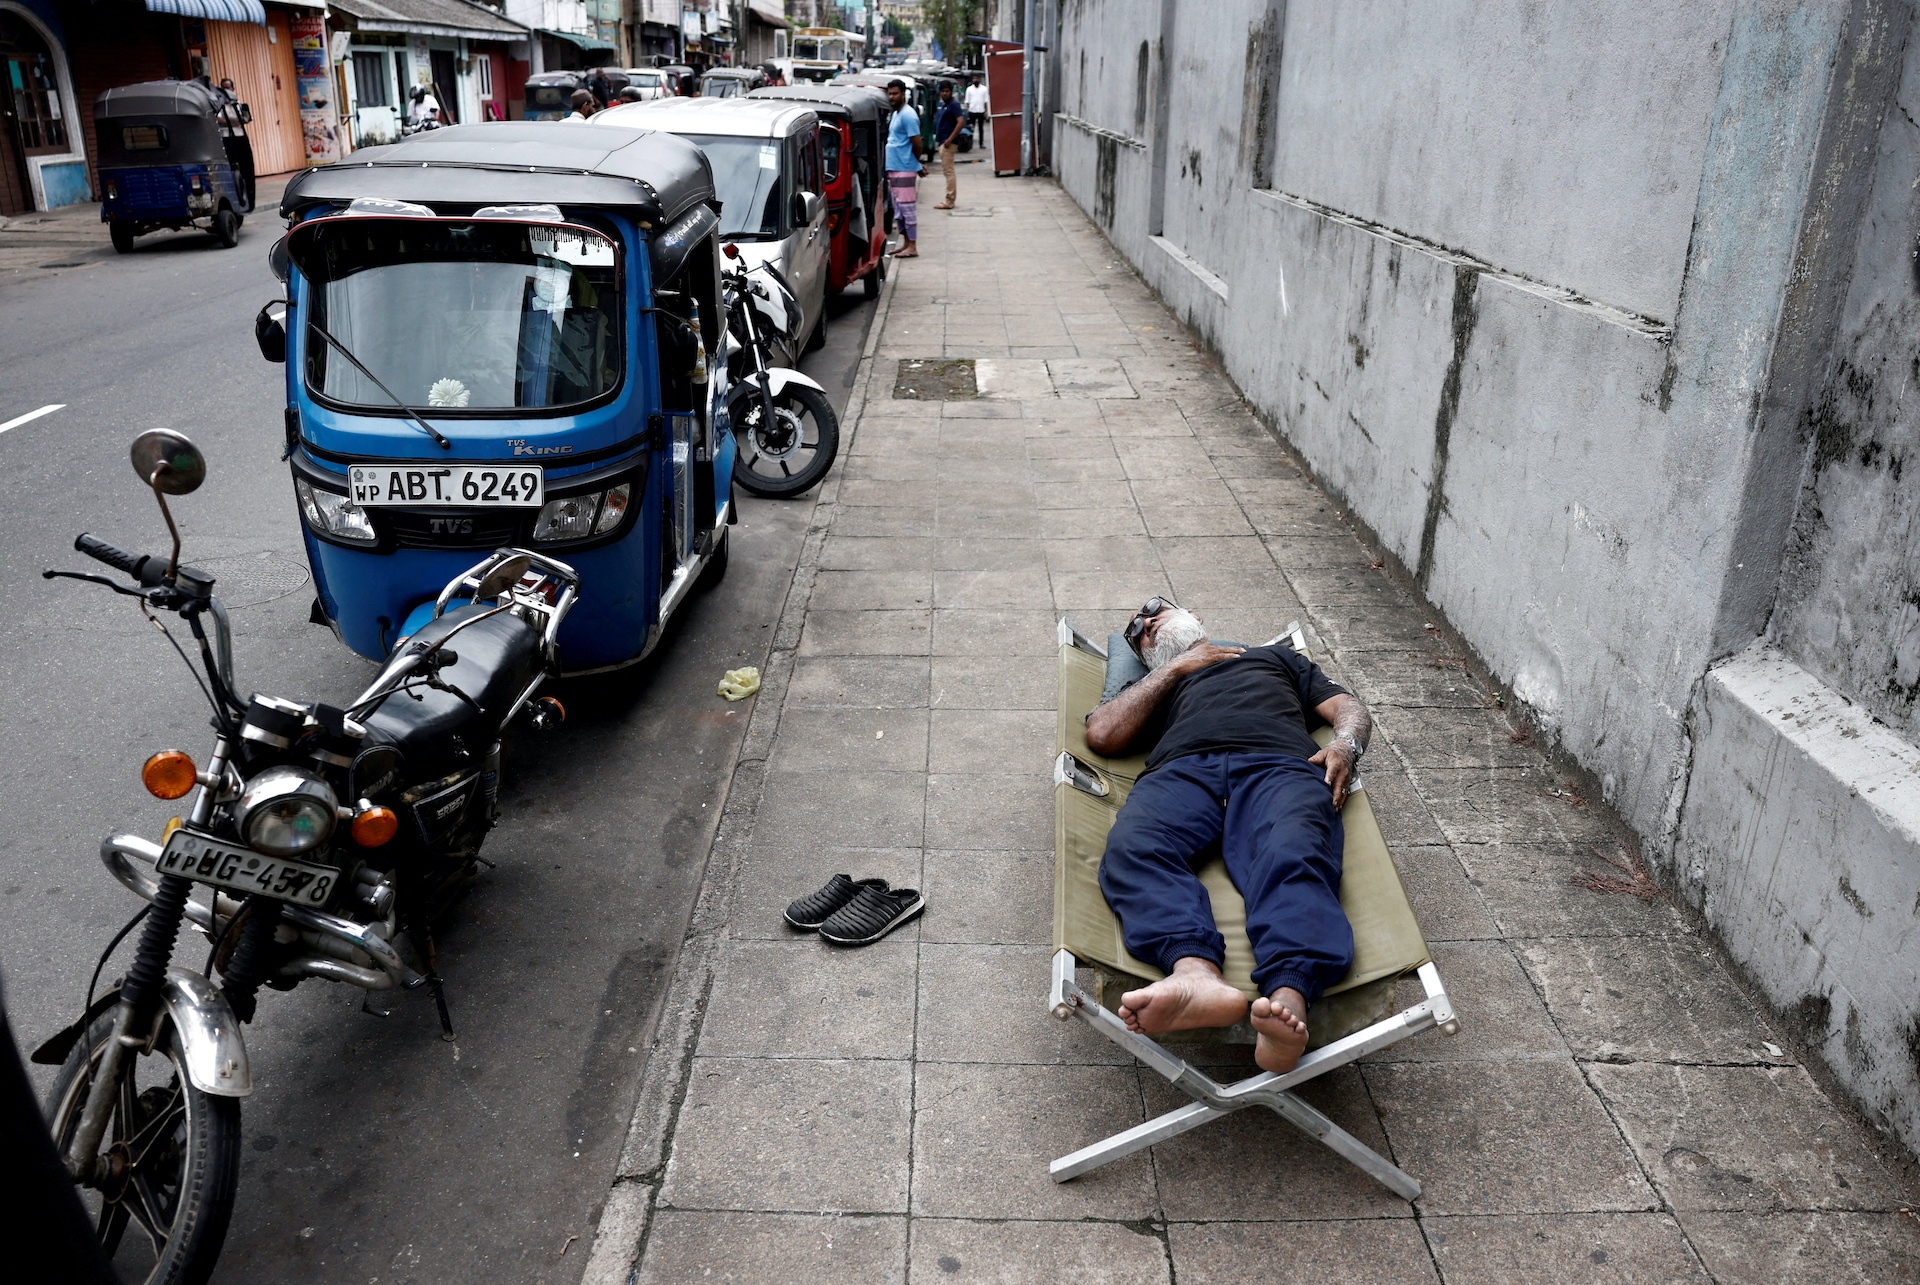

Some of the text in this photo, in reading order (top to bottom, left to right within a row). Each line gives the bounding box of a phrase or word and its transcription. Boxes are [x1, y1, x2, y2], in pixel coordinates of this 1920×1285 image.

[506, 439, 526, 447] TVS
[355, 484, 380, 501] WP
[461, 471, 538, 502] 6249
[430, 518, 473, 534] TVS
[164, 850, 197, 872] WP
